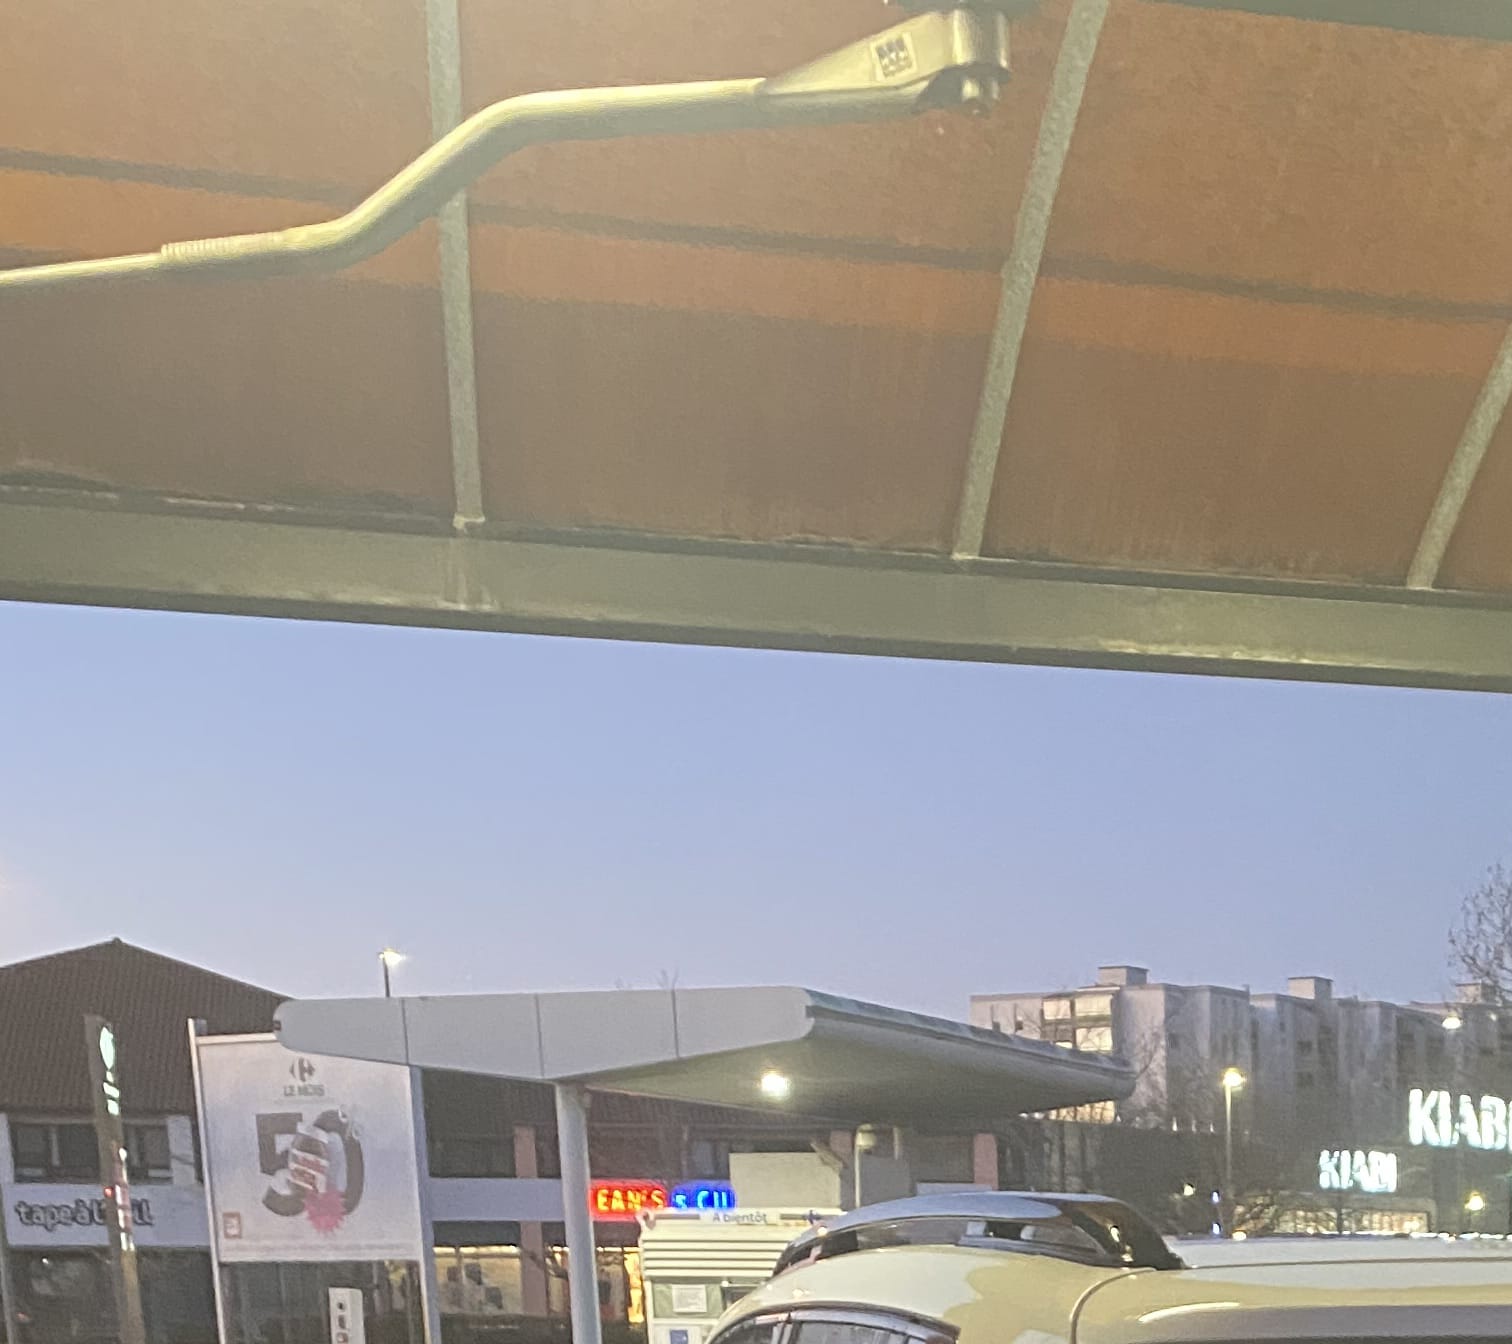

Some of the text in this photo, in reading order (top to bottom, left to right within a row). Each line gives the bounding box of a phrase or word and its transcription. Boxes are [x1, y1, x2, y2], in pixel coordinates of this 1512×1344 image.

[1319, 1150, 1398, 1192] KIABI
[597, 1189, 664, 1211] EAN'S
[14, 1201, 72, 1232] tape
